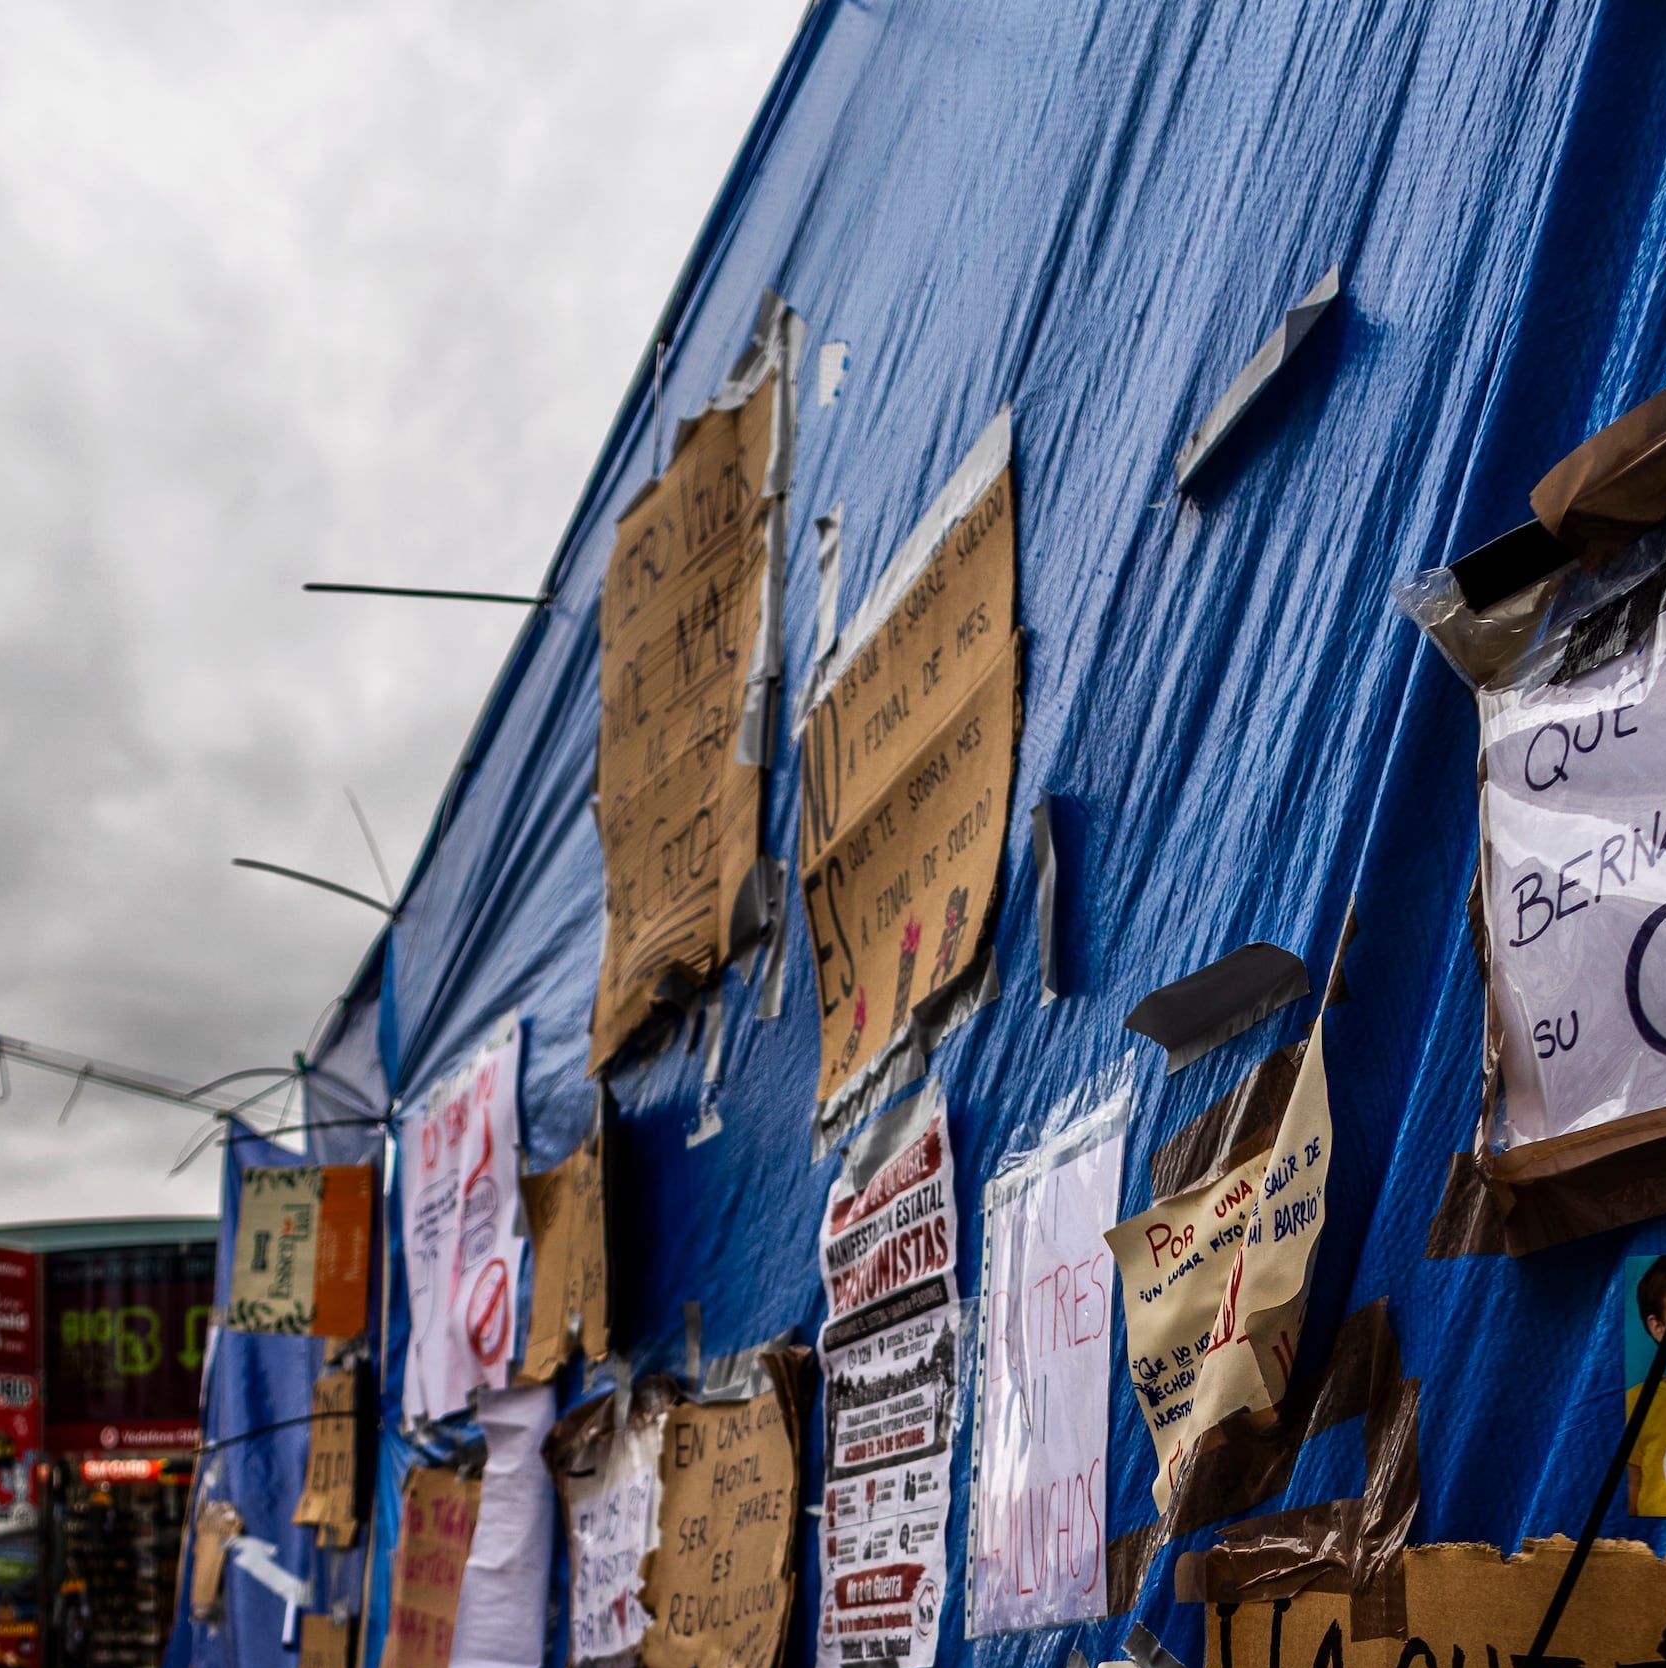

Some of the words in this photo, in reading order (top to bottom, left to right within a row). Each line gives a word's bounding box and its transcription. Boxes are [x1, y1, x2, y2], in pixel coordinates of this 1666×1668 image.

[1532, 1007, 1580, 1060] SU
[1304, 1136, 1321, 1170] DE
[896, 1179, 946, 1231] ESTATAL
[1145, 1222, 1194, 1268] POR
[1214, 1179, 1253, 1219] UNA
[1167, 1251, 1204, 1290] LUGAR
[1174, 1340, 1192, 1365] NO
[674, 1421, 707, 1469] EN
[717, 1406, 752, 1450] UNA
[711, 1453, 762, 1501] HOSTIL
[678, 1515, 708, 1556] SER
[711, 1550, 732, 1583] ES
[846, 1578, 856, 1604] No
[873, 1574, 903, 1600] Guerra
